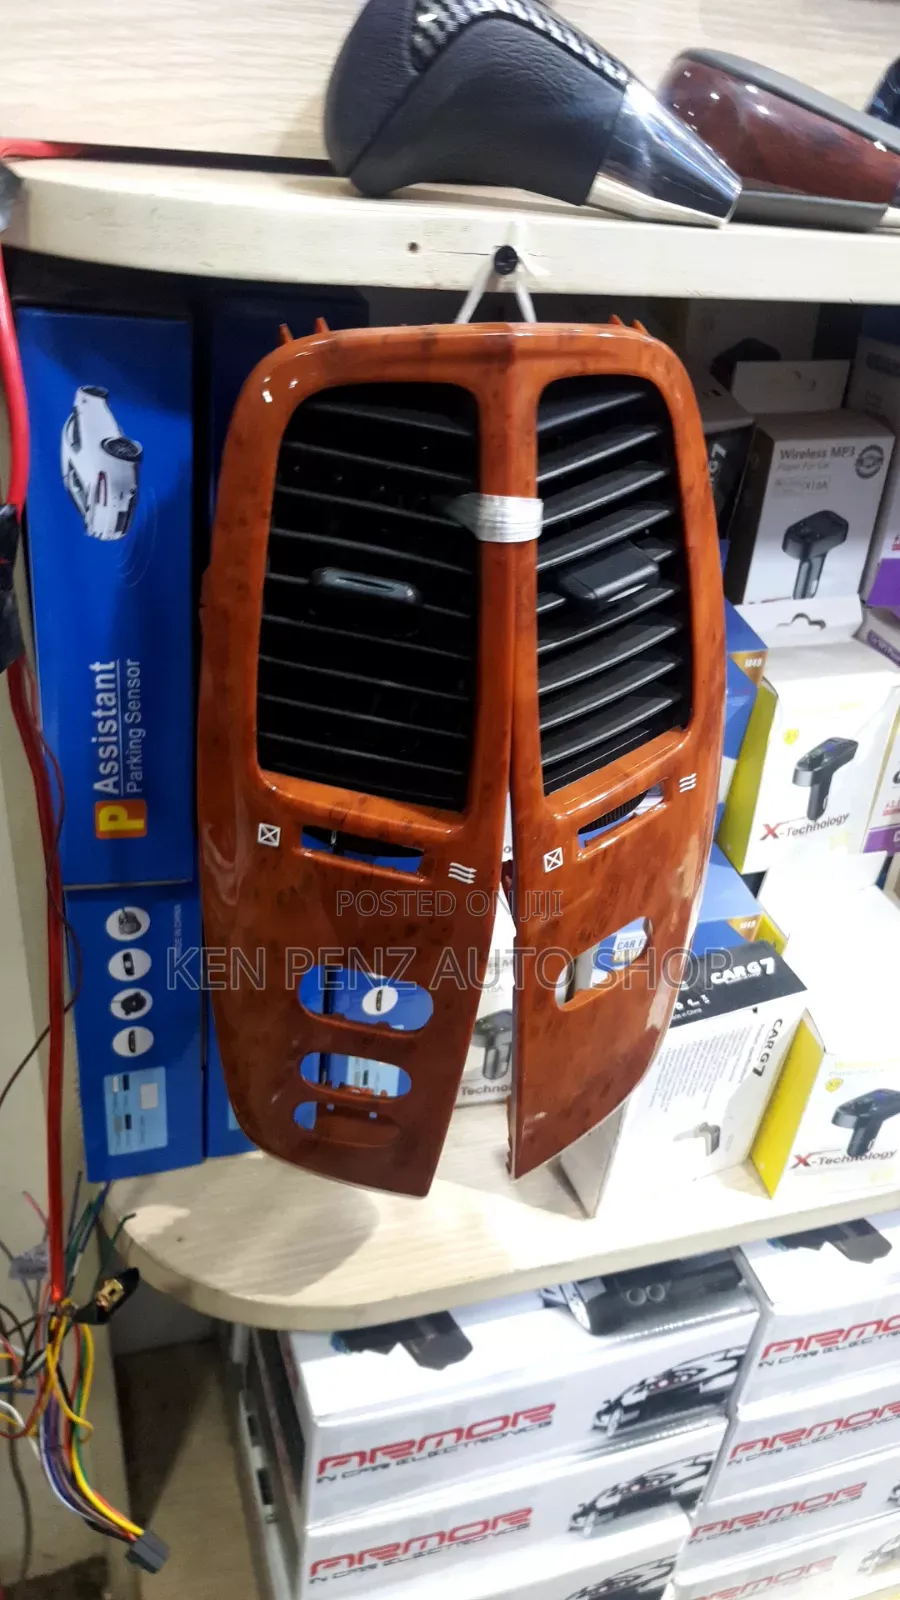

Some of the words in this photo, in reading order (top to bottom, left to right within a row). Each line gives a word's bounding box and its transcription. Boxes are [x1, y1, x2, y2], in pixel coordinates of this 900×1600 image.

[780, 447, 827, 460] Wireless
[830, 445, 856, 458] MP3
[125, 658, 141, 724] Sensor
[89, 661, 119, 795] Assistant
[126, 727, 146, 793] Parking
[98, 804, 145, 832] P
[760, 812, 850, 841] X-Technology
[617, 940, 635, 950] CAR
[790, 1148, 898, 1169] X-Technology
[317, 1402, 556, 1476] ARMOR
[690, 1481, 867, 1538] ARMOR
[310, 1507, 533, 1577] ARMOR
